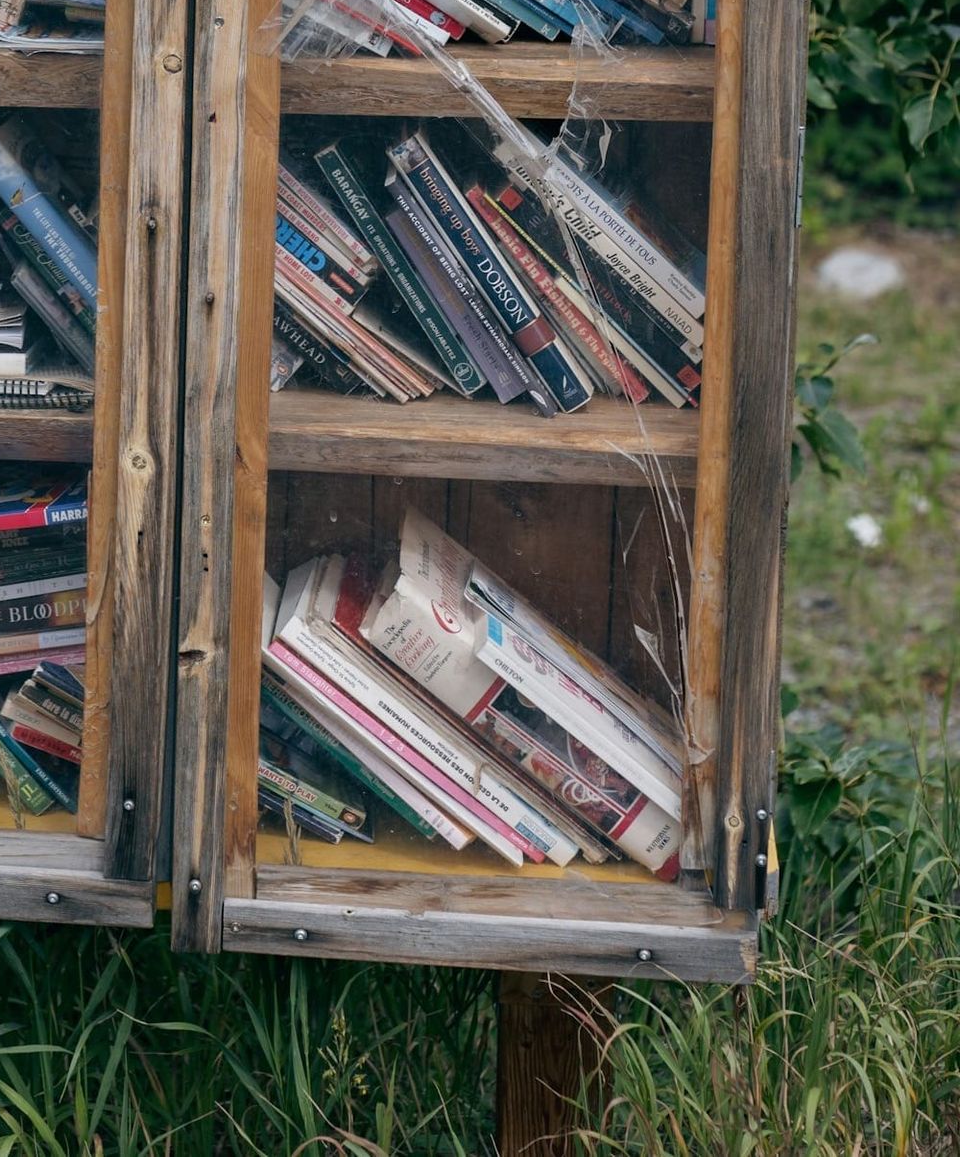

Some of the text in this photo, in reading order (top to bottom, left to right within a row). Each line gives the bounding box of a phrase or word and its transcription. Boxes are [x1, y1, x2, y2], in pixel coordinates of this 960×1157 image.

[43, 233, 58, 251] THE
[331, 168, 427, 314] BARANGAY ITS OPERATIONS ORGANIZATIONS
[419, 167, 481, 256] bringing up boys
[589, 199, 603, 215] LA
[601, 209, 630, 239] PORTÉE
[625, 234, 639, 248] DE
[636, 244, 658, 266] TOUS
[299, 267, 316, 284] LOSS
[396, 195, 469, 297] THIS ACCIDENT OF BEING LOST
[564, 205, 602, 242] Child
[606, 250, 633, 278] Joyce
[629, 271, 656, 301] Bright
[477, 259, 529, 324] DOBSON
[521, 254, 541, 279] Fly
[539, 278, 583, 330] Fishing
[584, 335, 601, 353] Fly
[664, 307, 692, 335] NAIAD
[467, 298, 486, 323] LEANNE
[511, 358, 531, 384] SIMPSON
[384, 622, 397, 636] The
[493, 657, 526, 684] CHILTON
[257, 765, 284, 787] WANTS
[282, 779, 297, 793] TO
[295, 786, 316, 804] PLAY
[376, 699, 510, 812] DE LA DES RESSOURCES HUMAINES
